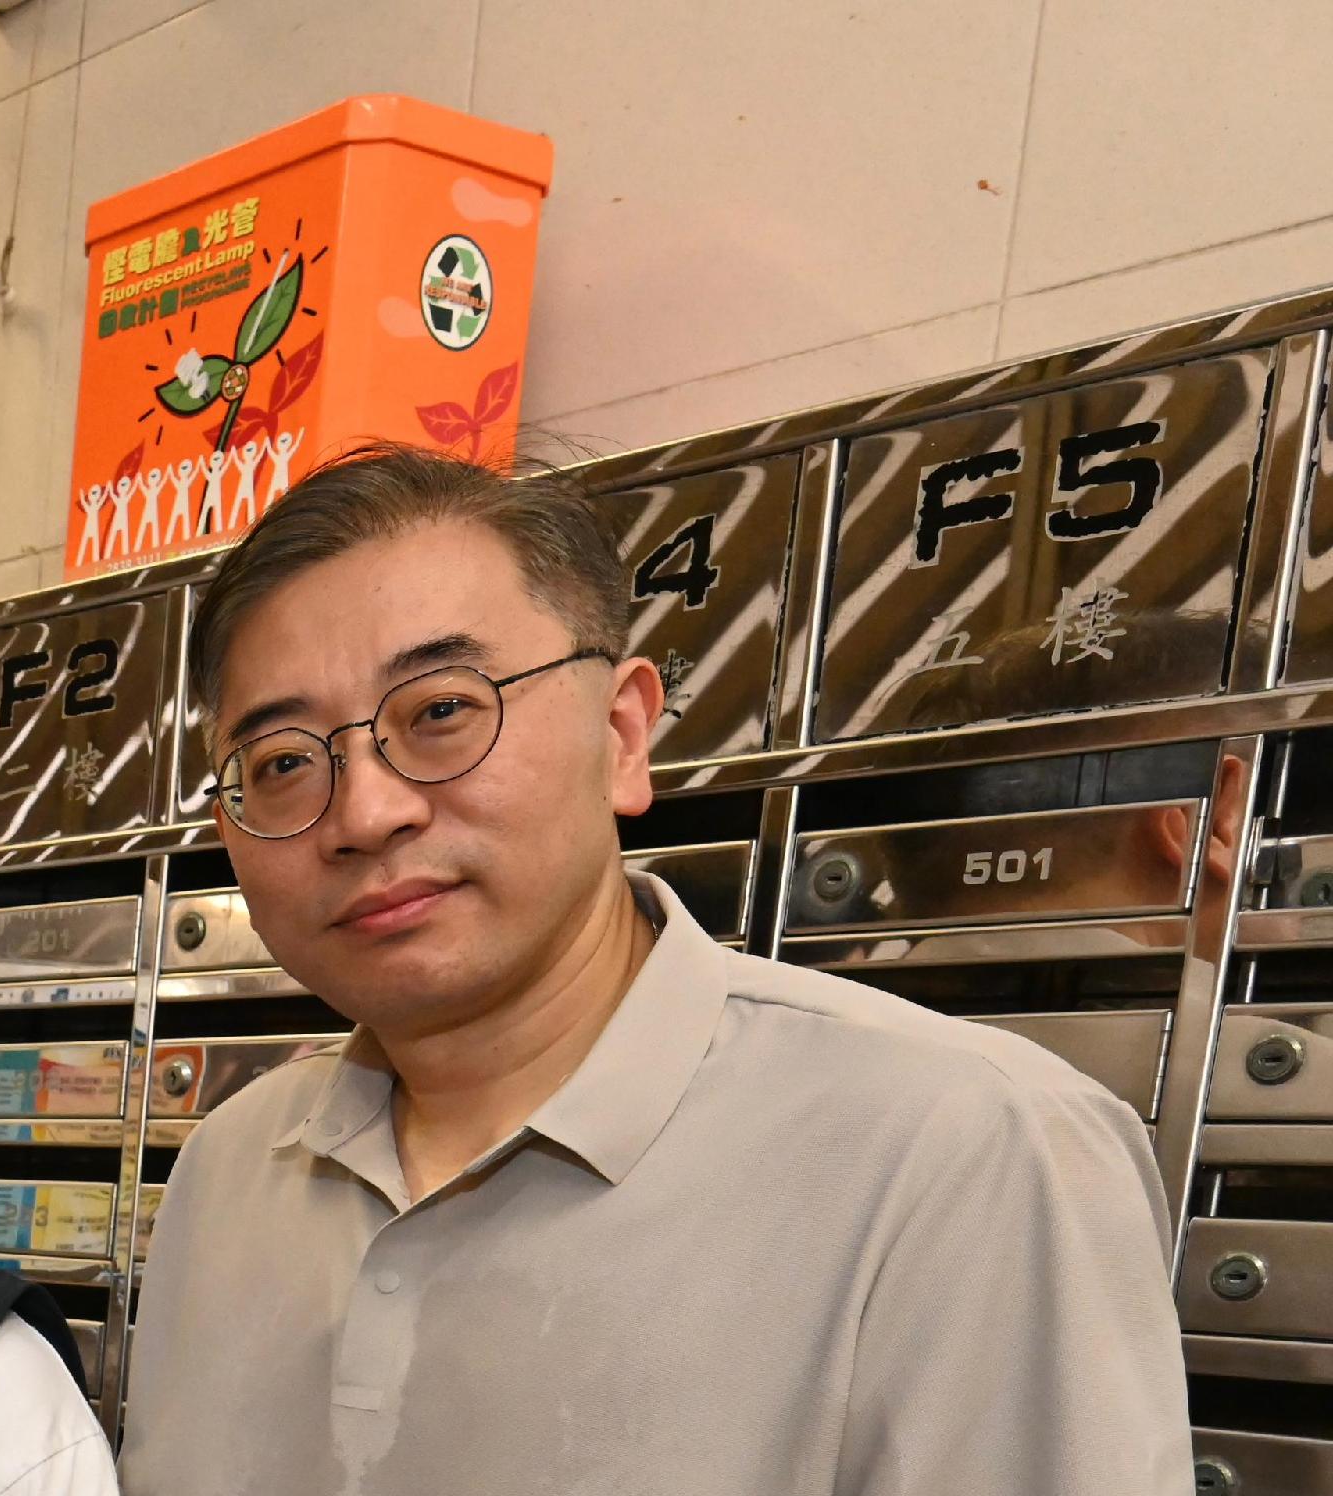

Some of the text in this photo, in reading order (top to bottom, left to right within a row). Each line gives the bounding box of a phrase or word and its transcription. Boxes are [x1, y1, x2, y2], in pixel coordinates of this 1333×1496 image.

[100, 240, 255, 308] Fluorescent Lamp
[908, 418, 1167, 570] F5
[915, 577, 1129, 673] 五樓
[962, 847, 1054, 885] 501
